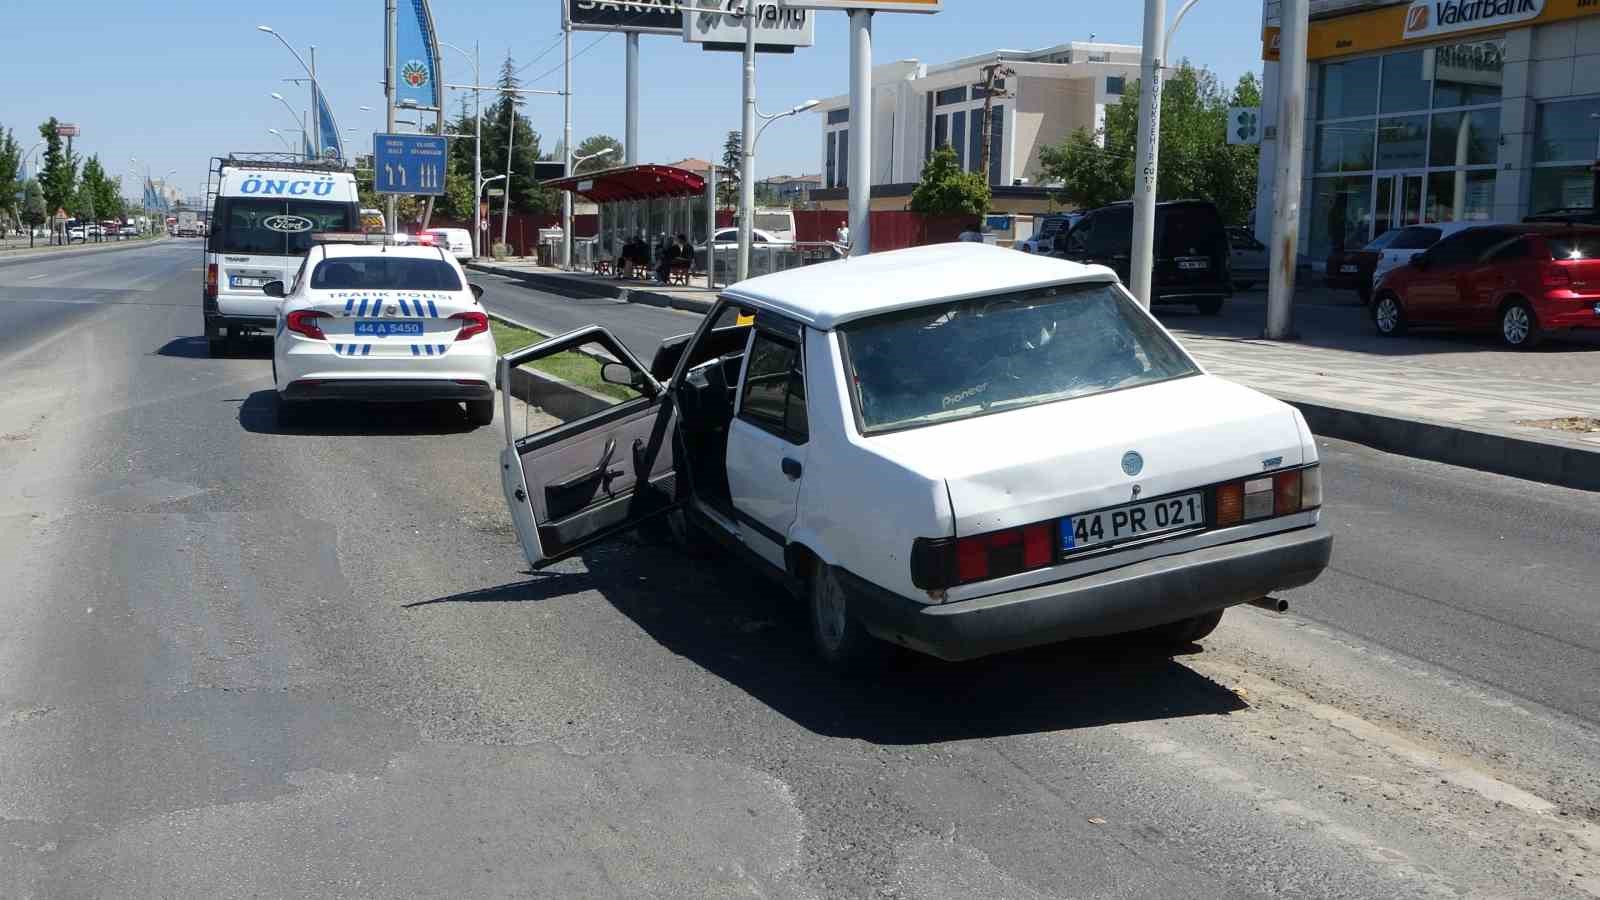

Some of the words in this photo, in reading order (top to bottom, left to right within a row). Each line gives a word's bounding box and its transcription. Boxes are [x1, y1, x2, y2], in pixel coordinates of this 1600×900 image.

[240, 174, 336, 196] ÖNCÜ
[273, 216, 304, 230] Ford
[358, 323, 374, 333] 44
[377, 323, 386, 333] A
[390, 323, 418, 333] 5450
[1075, 517, 1105, 544] 44
[1112, 507, 1147, 538] PR
[1155, 497, 1197, 529] 021
